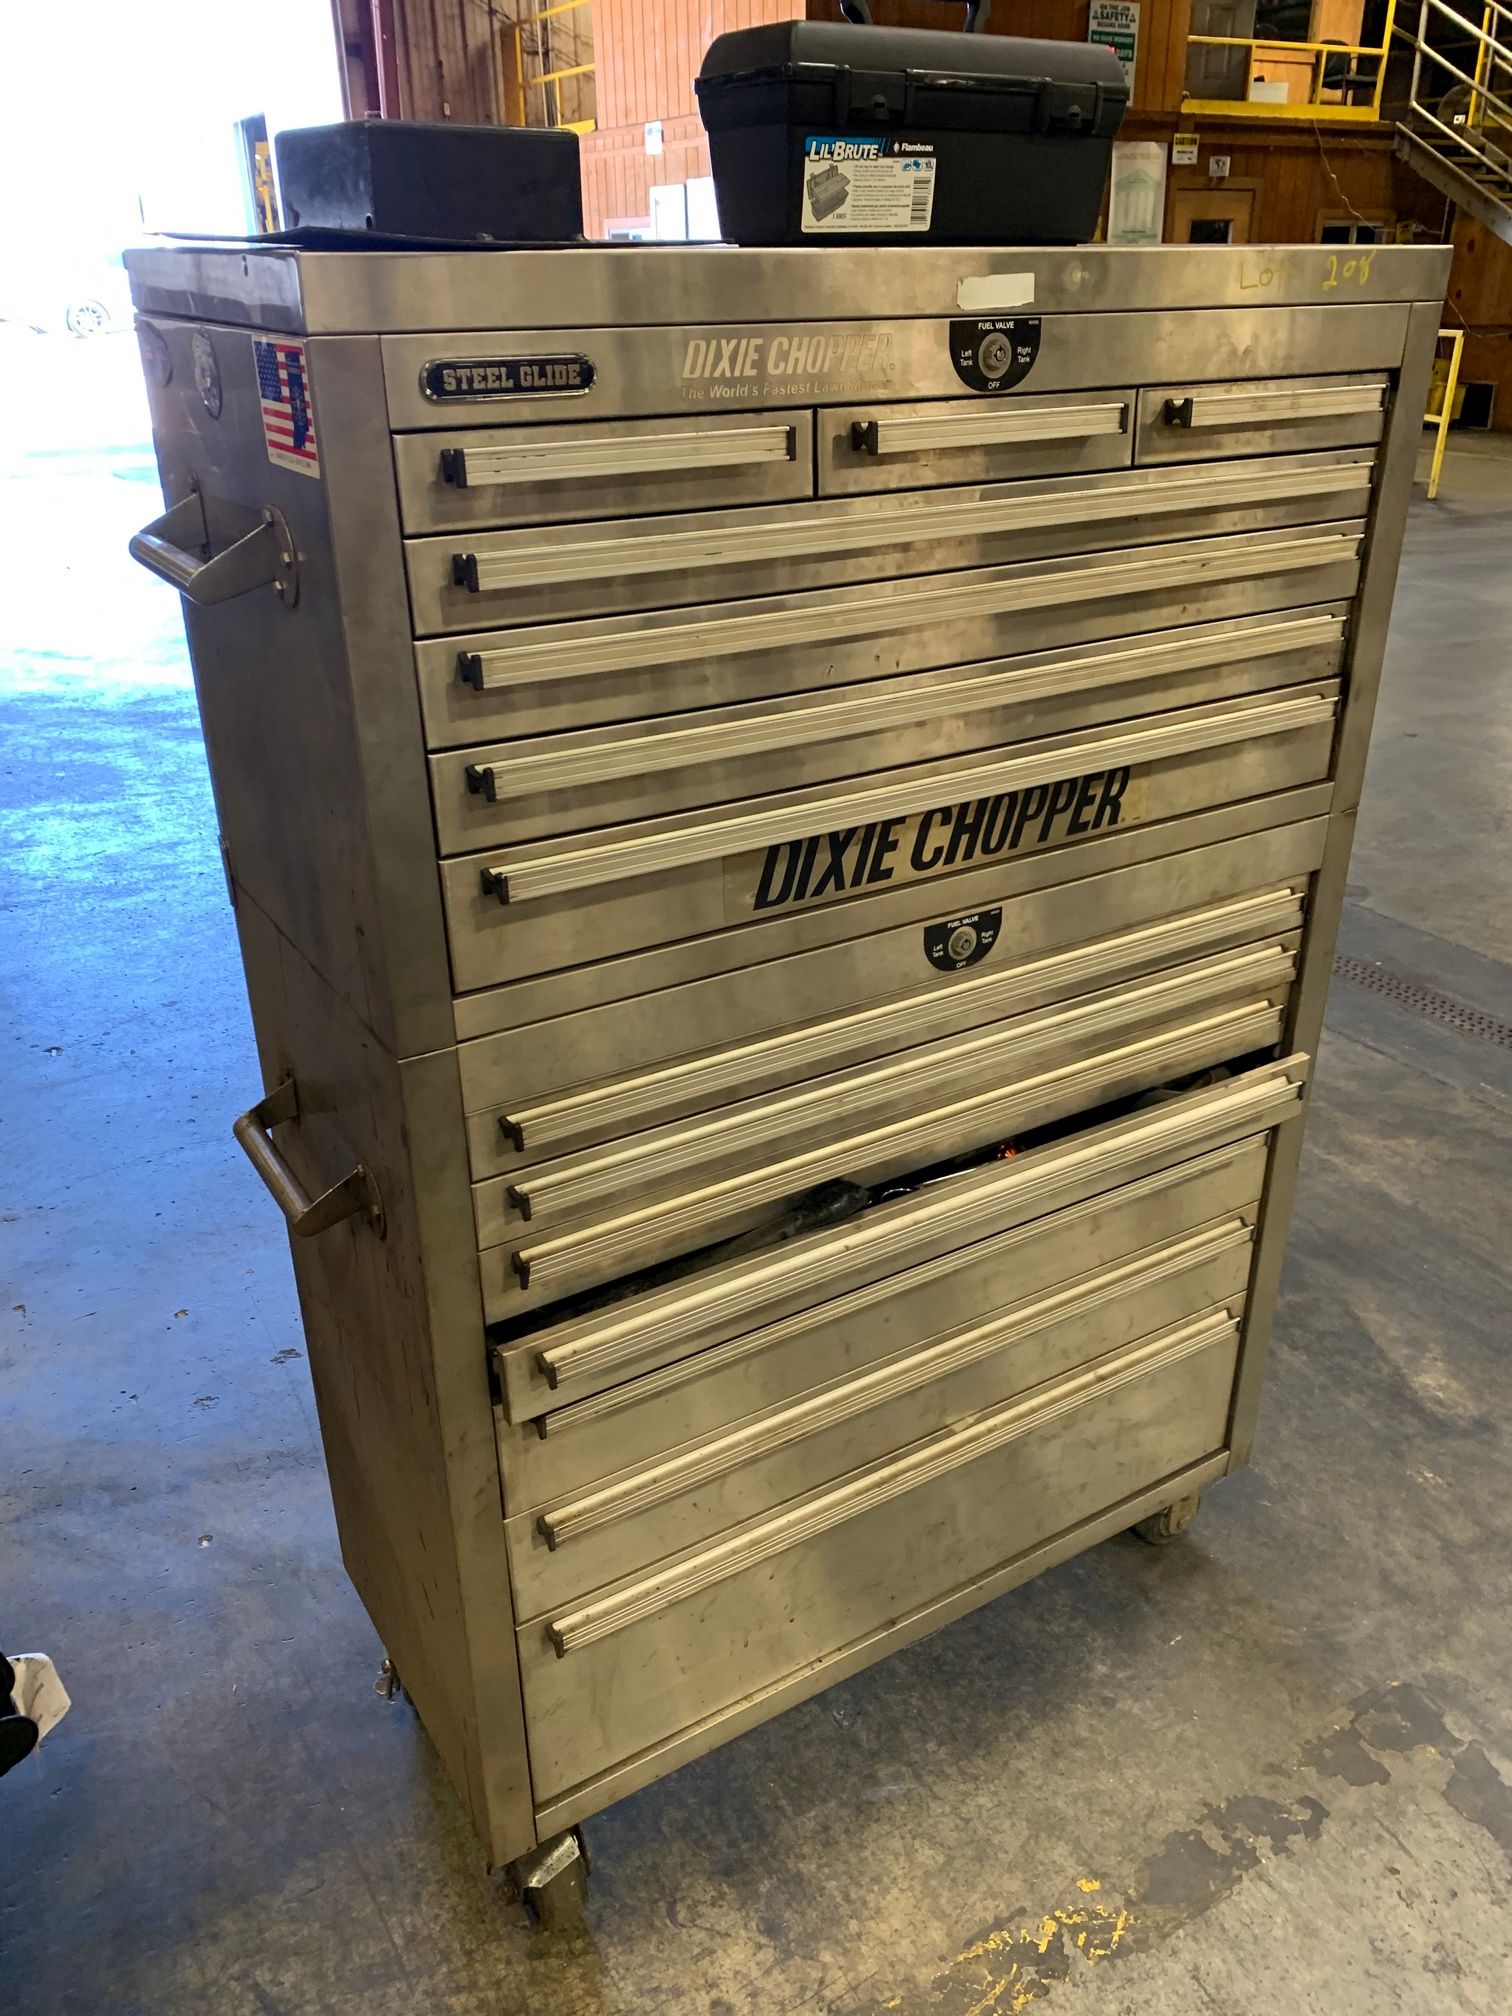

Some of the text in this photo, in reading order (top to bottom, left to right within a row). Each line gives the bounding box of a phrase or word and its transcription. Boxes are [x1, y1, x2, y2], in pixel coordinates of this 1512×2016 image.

[1100, 10, 1130, 22] SAFETY
[901, 142, 934, 152] Flambeau
[1322, 250, 1377, 291] 208
[978, 321, 1015, 330] FUEL VALVE
[682, 333, 894, 379] DIXIE CHOPPER
[961, 349, 972, 358] Left
[1017, 346, 1032, 356] Right
[960, 358, 973, 367] Tank
[1017, 355, 1031, 363] Tank
[442, 364, 581, 391] STEEL GLIDE
[681, 385, 705, 399] The
[709, 382, 759, 399] World's
[763, 381, 811, 396] Fastest
[987, 381, 1000, 390] OFF
[753, 765, 1132, 911] DIXIE CHOPPER
[947, 915, 980, 929] FUEL VALVE
[956, 960, 967, 969] OFF
